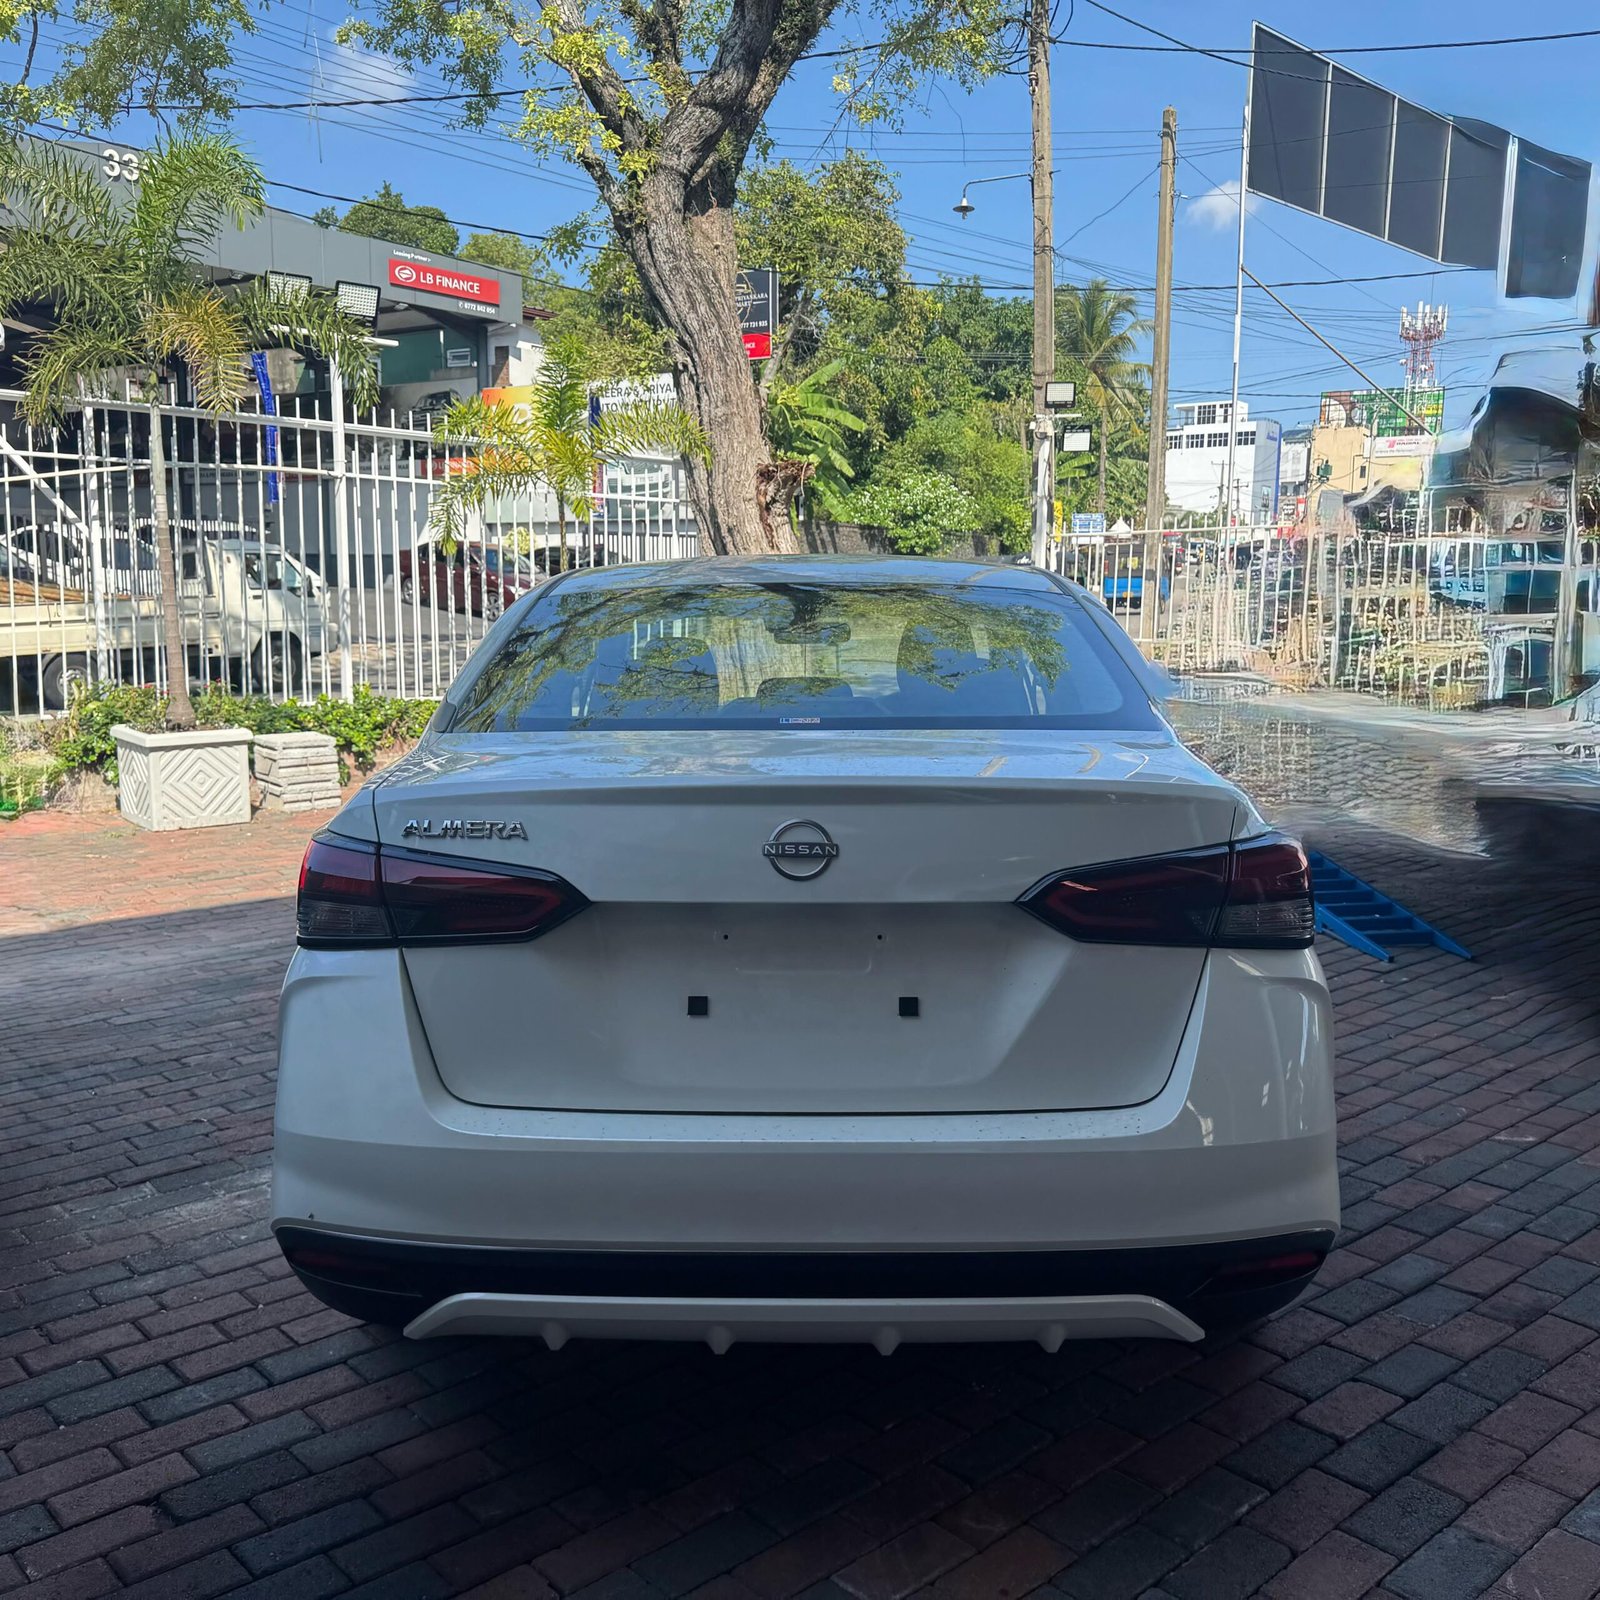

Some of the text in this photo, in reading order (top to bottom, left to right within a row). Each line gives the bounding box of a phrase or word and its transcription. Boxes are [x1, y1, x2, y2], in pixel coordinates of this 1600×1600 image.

[103, 149, 152, 181] 33
[420, 271, 480, 294] LB FINANCE
[402, 819, 528, 840] ALMERA
[764, 844, 837, 855] NISSAN
